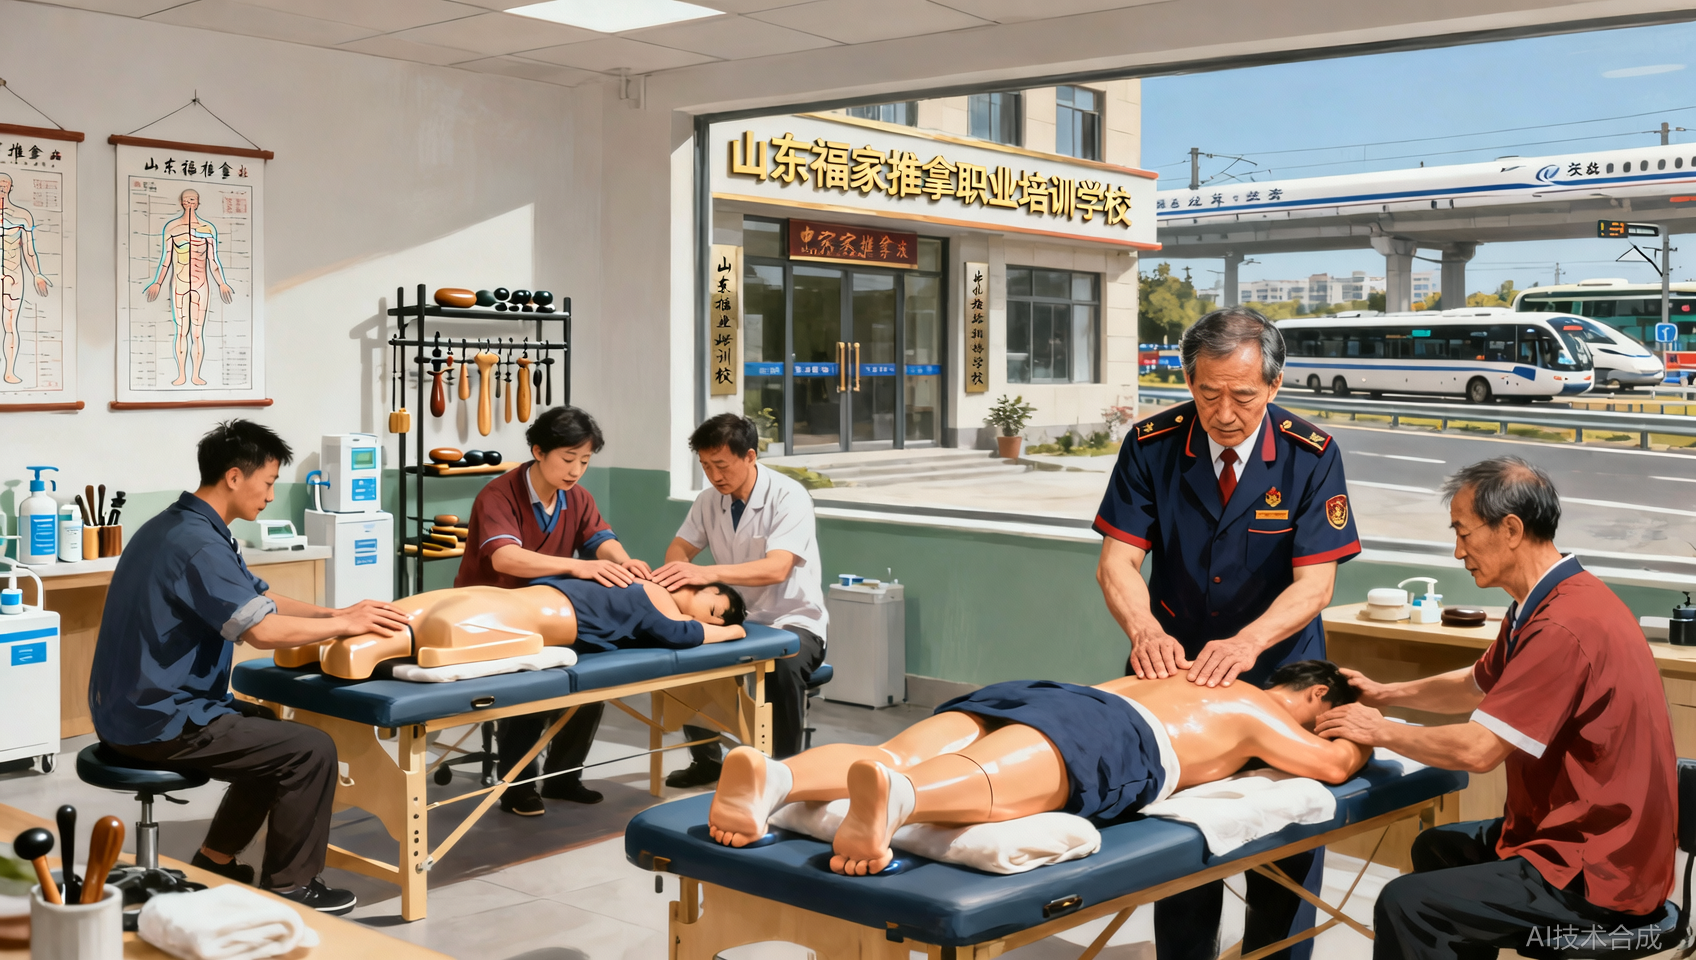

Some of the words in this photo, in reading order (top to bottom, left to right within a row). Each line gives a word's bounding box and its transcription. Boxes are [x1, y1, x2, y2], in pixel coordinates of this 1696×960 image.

[730, 131, 1133, 227] 山东福家推拿职业培训学校
